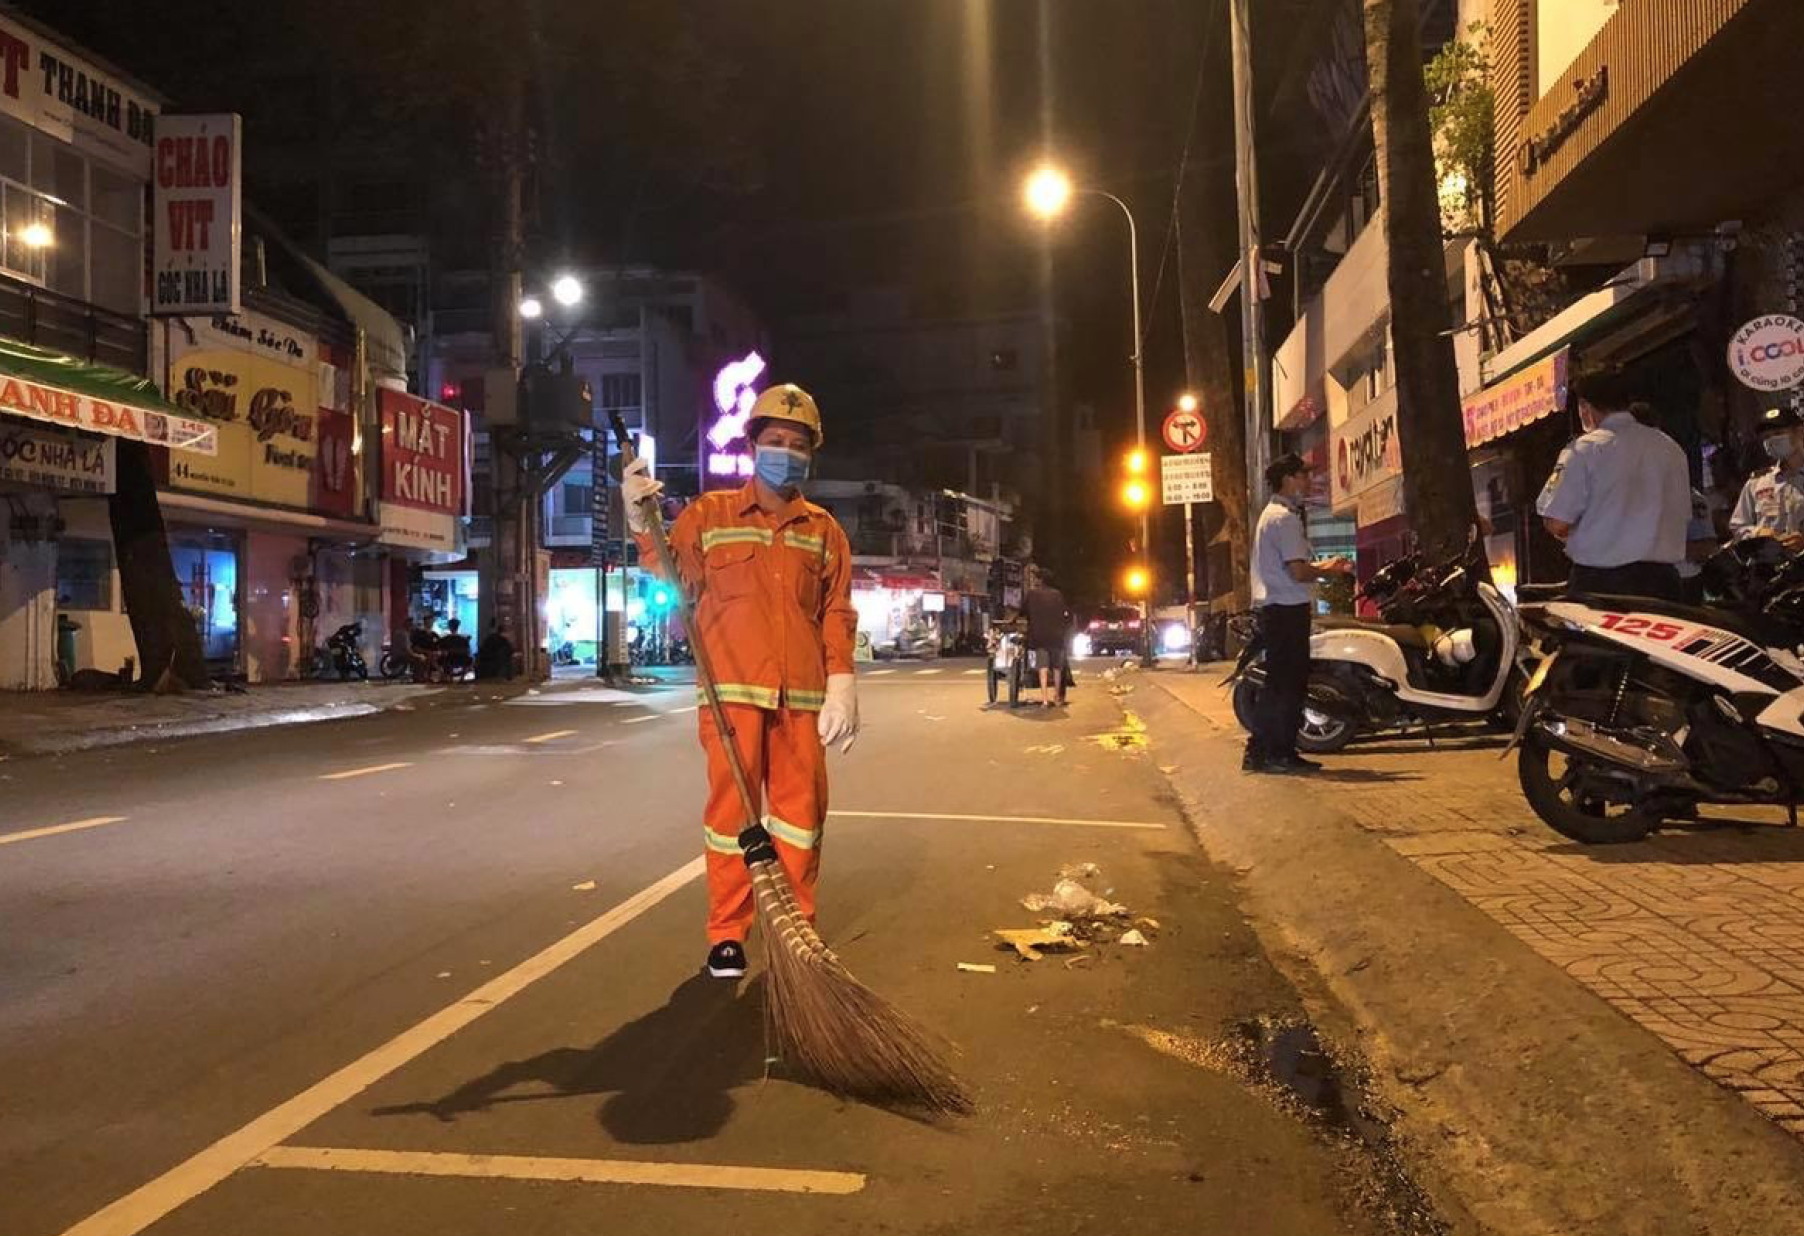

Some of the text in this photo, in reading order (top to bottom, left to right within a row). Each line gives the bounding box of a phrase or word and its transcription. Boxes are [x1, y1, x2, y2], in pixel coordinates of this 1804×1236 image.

[40, 51, 121, 132] THANH
[158, 122, 228, 189] CHÁO
[91, 400, 142, 435] ĐA
[397, 401, 450, 459] MẮT
[395, 454, 452, 507] KÍNH
[1599, 614, 1684, 640] 125
